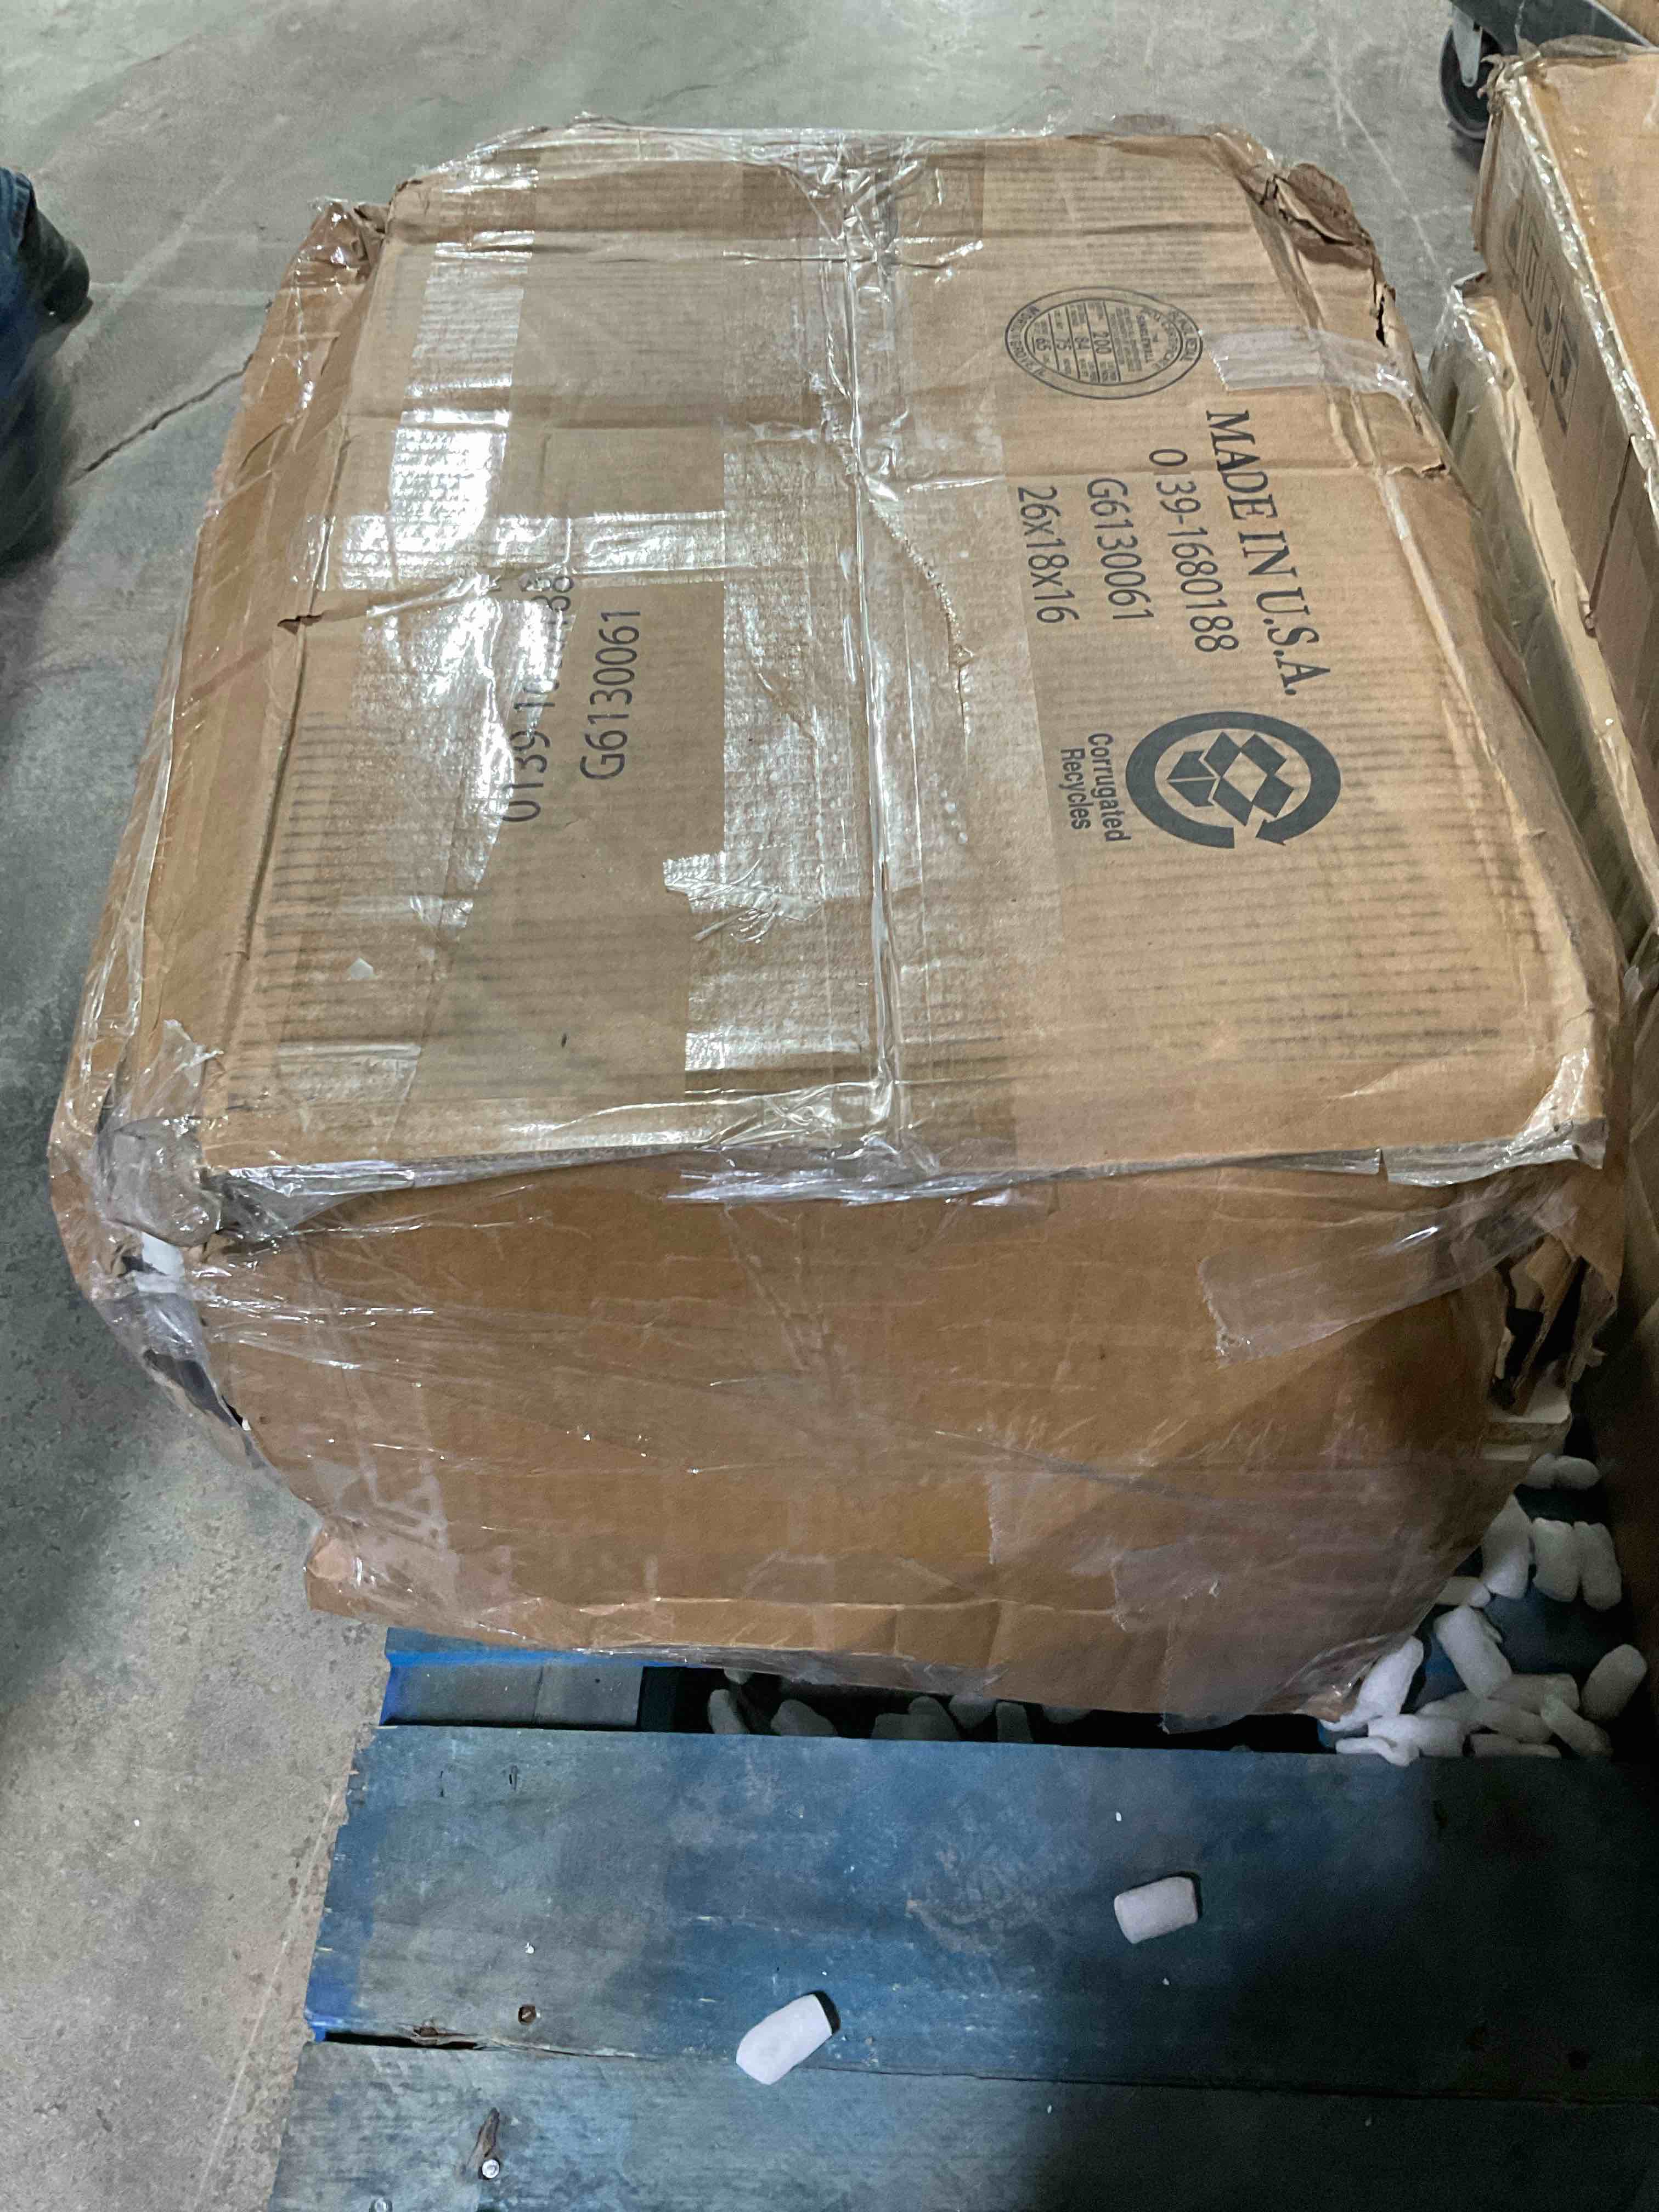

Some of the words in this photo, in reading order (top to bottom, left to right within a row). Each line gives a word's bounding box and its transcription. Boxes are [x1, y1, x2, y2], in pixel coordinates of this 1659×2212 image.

[1035, 337, 1052, 351] 65
[1055, 337, 1071, 351] 75
[1092, 331, 1112, 354] 200
[1206, 409, 1279, 520] MADE
[1017, 485, 1080, 624] 26x18x16
[1087, 477, 1155, 620] G6130061
[1238, 532, 1297, 577] IN
[580, 610, 641, 780] G6130061
[1256, 586, 1331, 696] U.S.A.
[1058, 747, 1094, 830] Recycles
[1088, 733, 1132, 842] Corrugated
